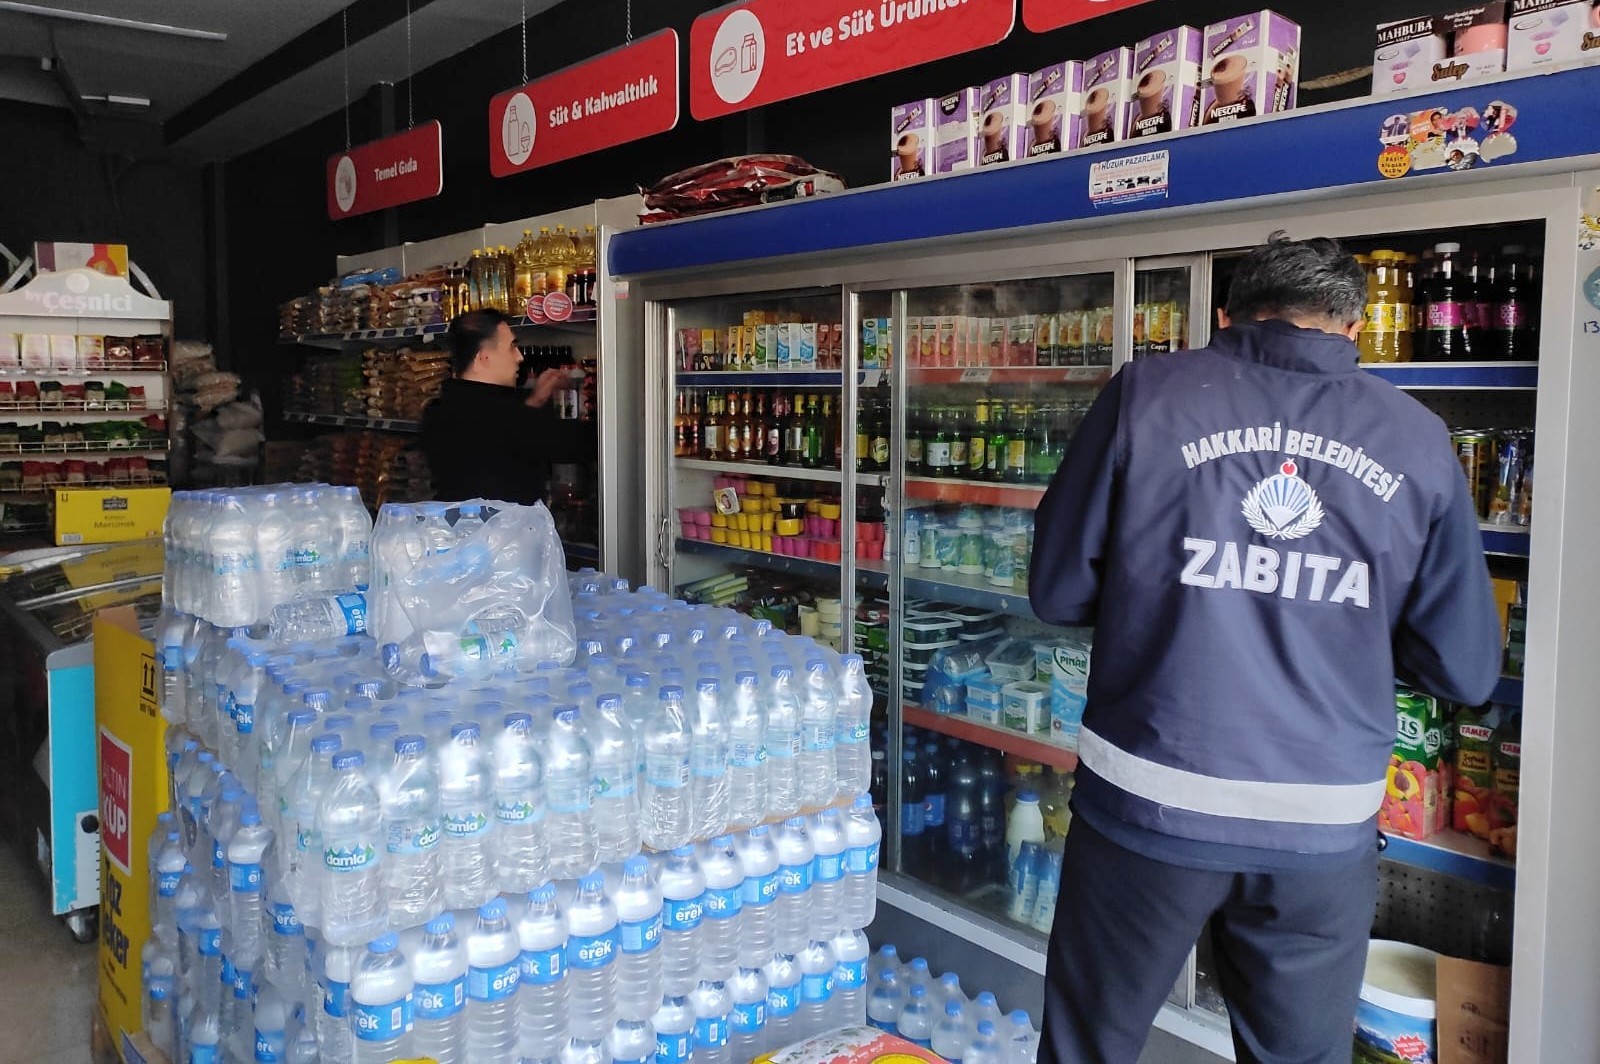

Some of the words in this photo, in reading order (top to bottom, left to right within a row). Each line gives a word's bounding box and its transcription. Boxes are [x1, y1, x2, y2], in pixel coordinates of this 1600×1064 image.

[786, 32, 805, 57] Et
[810, 26, 833, 49] ve
[838, 9, 874, 41] Süt
[1376, 19, 1434, 43] MAHBUBA
[549, 105, 569, 129] Süt
[571, 100, 583, 121] &
[585, 74, 658, 117] Kahvaltılık
[374, 162, 398, 182] Temel
[399, 158, 418, 176] Gıda
[1125, 152, 1166, 166] PAZARLAMA
[42, 293, 132, 315] Çeşnici
[1181, 421, 1282, 469] HAKKARİ
[1284, 429, 1405, 503] BELEDİYESİ
[1180, 537, 1370, 609] ZABITA
[326, 853, 366, 867] damla
[578, 940, 613, 960] erek
